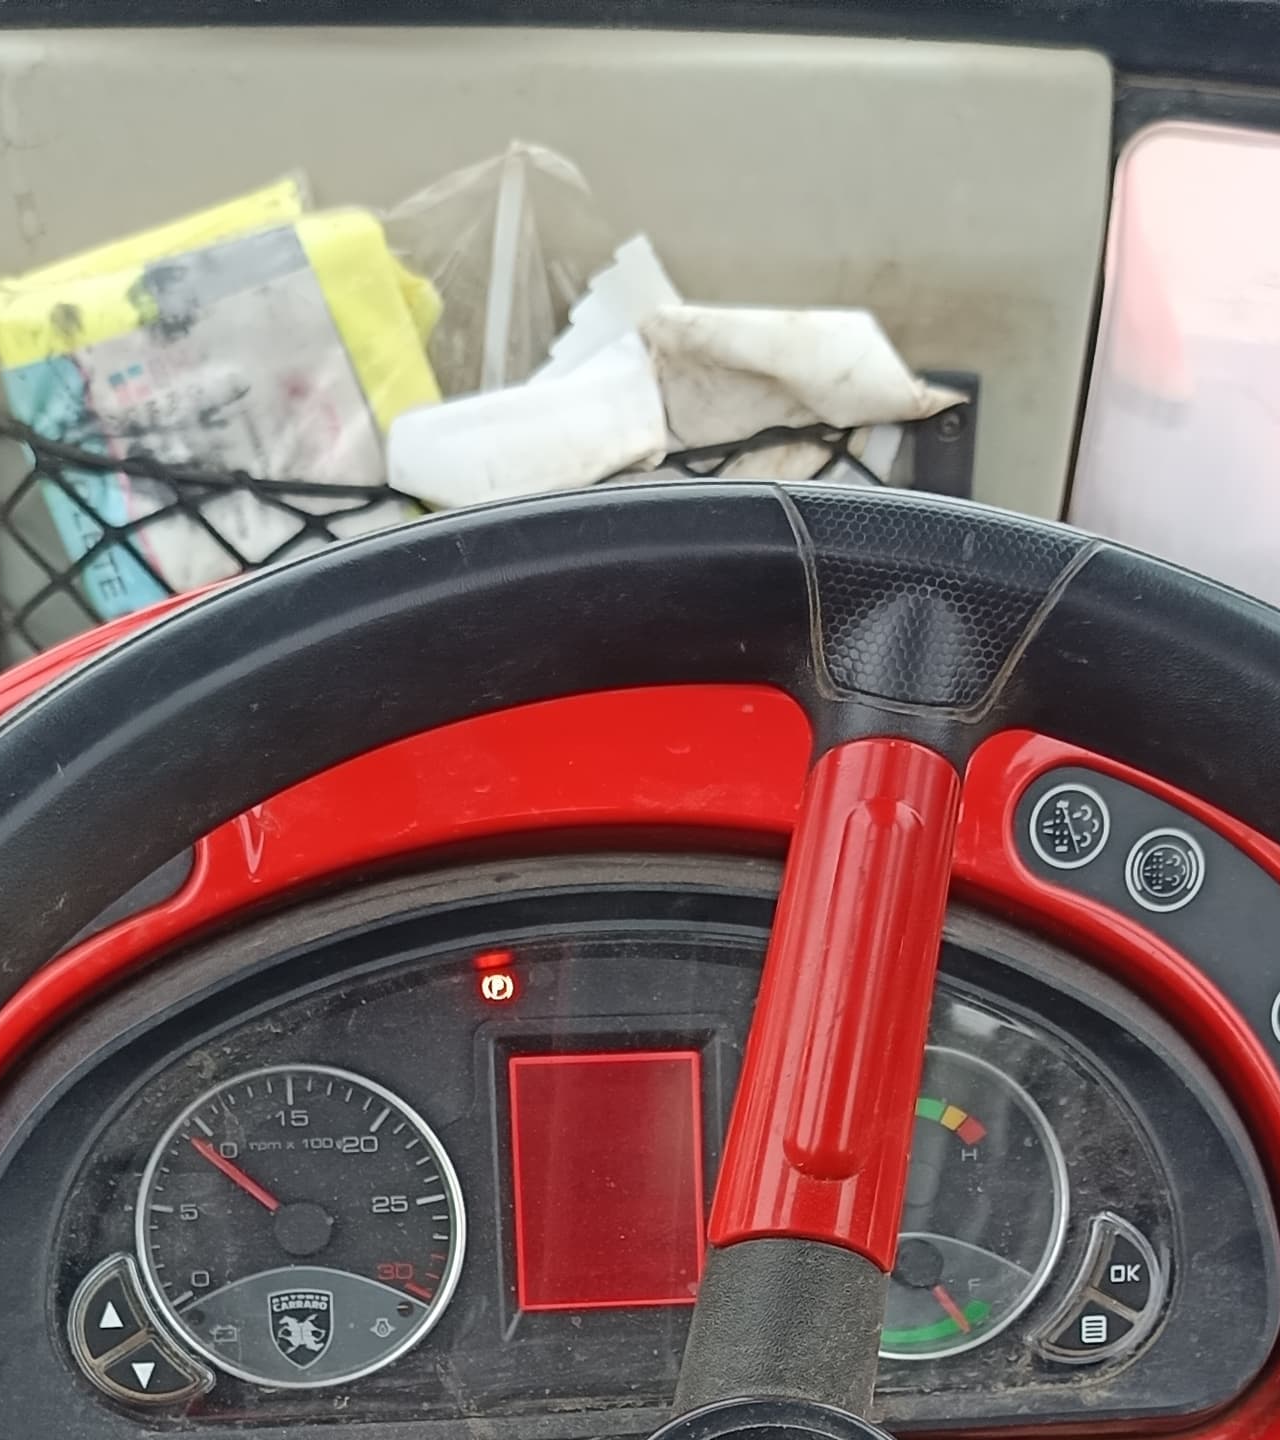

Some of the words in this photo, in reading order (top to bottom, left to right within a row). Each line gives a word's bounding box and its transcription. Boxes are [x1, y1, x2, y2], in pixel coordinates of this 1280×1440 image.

[275, 1109, 309, 1127] 15
[248, 1142, 281, 1152] rpm
[302, 1137, 334, 1150] 100
[341, 1135, 379, 1154] 20
[960, 1148, 978, 1162] H
[180, 1203, 199, 1221] 5
[372, 1195, 409, 1213] 25
[191, 1271, 210, 1287] 0
[377, 1263, 414, 1280] 30
[1110, 1264, 1141, 1283] OK
[272, 1300, 328, 1312] CARRARO
